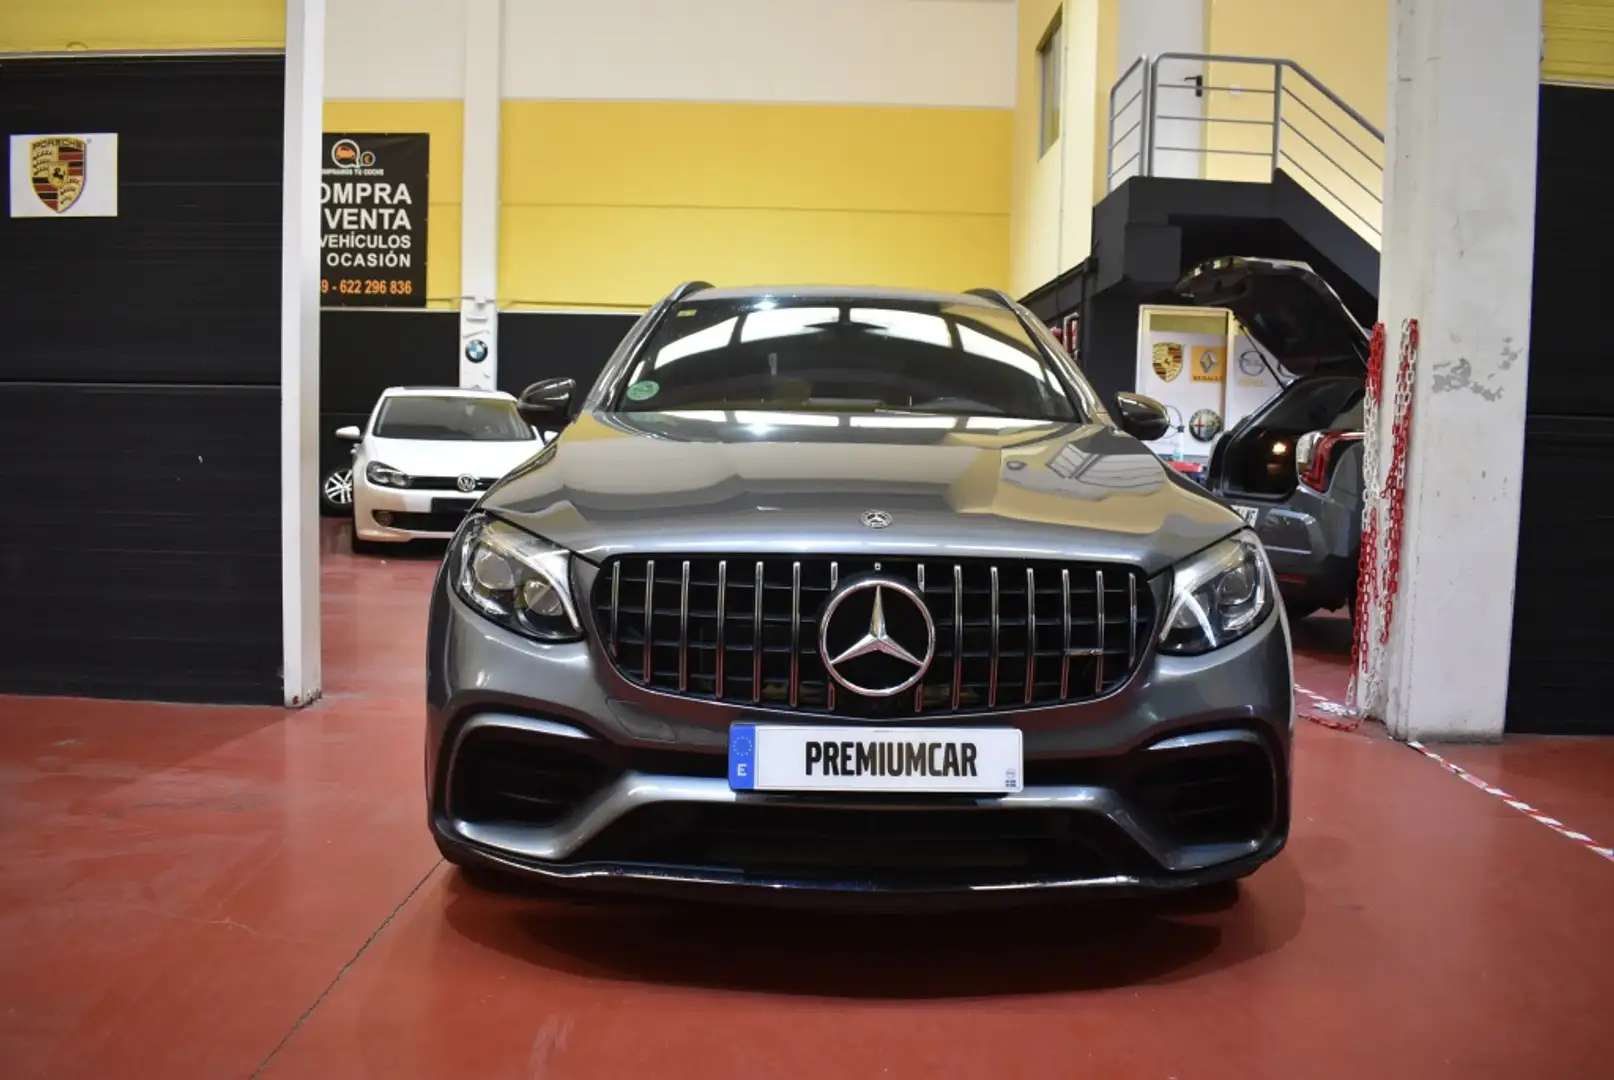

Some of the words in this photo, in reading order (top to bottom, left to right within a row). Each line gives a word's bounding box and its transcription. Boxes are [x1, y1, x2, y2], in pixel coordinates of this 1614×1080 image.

[320, 183, 412, 205] OMPRA
[324, 208, 412, 230] VENTA
[320, 231, 411, 249] VEHÍCULOS
[326, 250, 411, 268] OCASIÓN
[340, 280, 361, 294] 622
[365, 280, 387, 295] 296
[390, 280, 412, 295] 836
[805, 741, 977, 777] PREMIUMCAR
[737, 763, 747, 776] E
